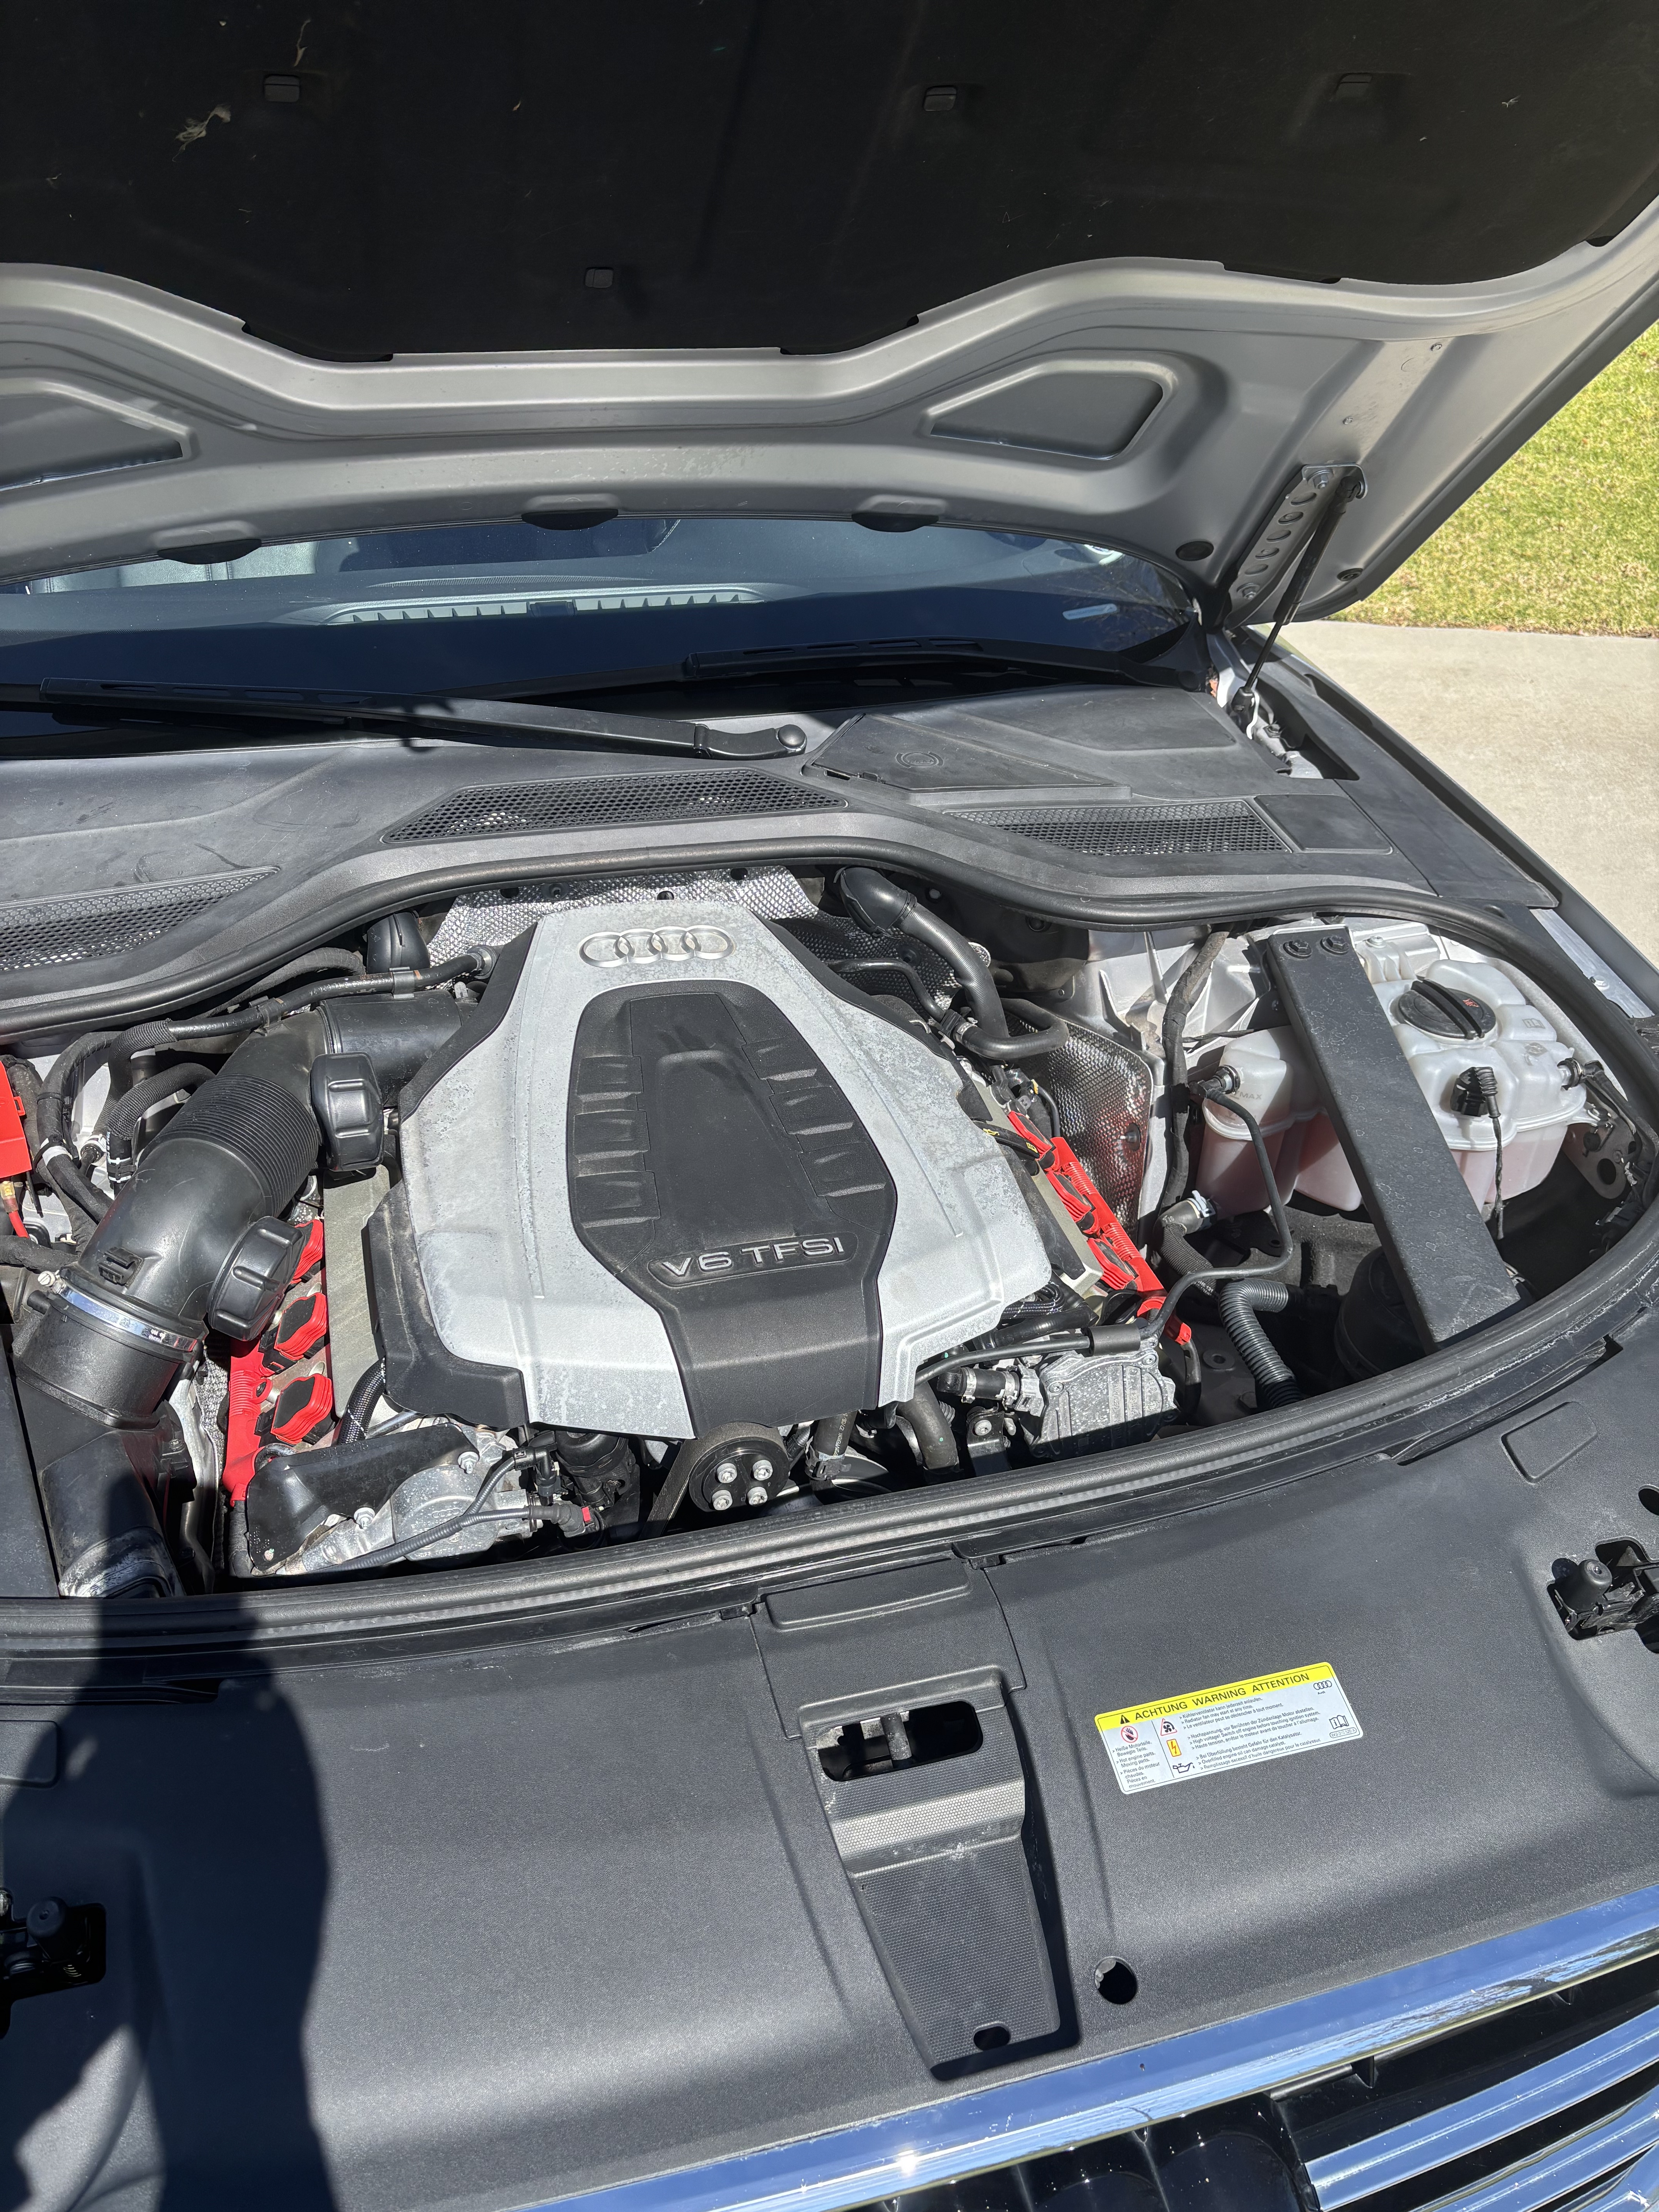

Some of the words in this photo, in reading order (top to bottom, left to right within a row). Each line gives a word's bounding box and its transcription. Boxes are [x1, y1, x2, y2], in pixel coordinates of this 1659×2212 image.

[1240, 1092, 1262, 1100] MAX
[661, 1251, 732, 1277] V6
[741, 1237, 844, 1265] TFSI
[1135, 1701, 1188, 1721] ACHTUNG
[1192, 1688, 1247, 1706] WARNING
[1252, 1673, 1310, 1693] ATTENTION
[1182, 1708, 1215, 1719] Kühlerventilator
[1225, 1701, 1244, 1709] jederzeit
[1192, 1719, 1214, 1727] ventilateur
[1230, 1710, 1252, 1718] déclencher
[1190, 1728, 1223, 1739] Hochspannung,
[1257, 1714, 1282, 1723] Zündanlage
[1128, 1740, 1152, 1749] Motorteile.
[1203, 1733, 1221, 1741] voltage!
[1202, 1755, 1223, 1764] Overfilled
[1203, 1760, 1231, 1769] Remplissage
[1231, 1755, 1248, 1763] excessif
